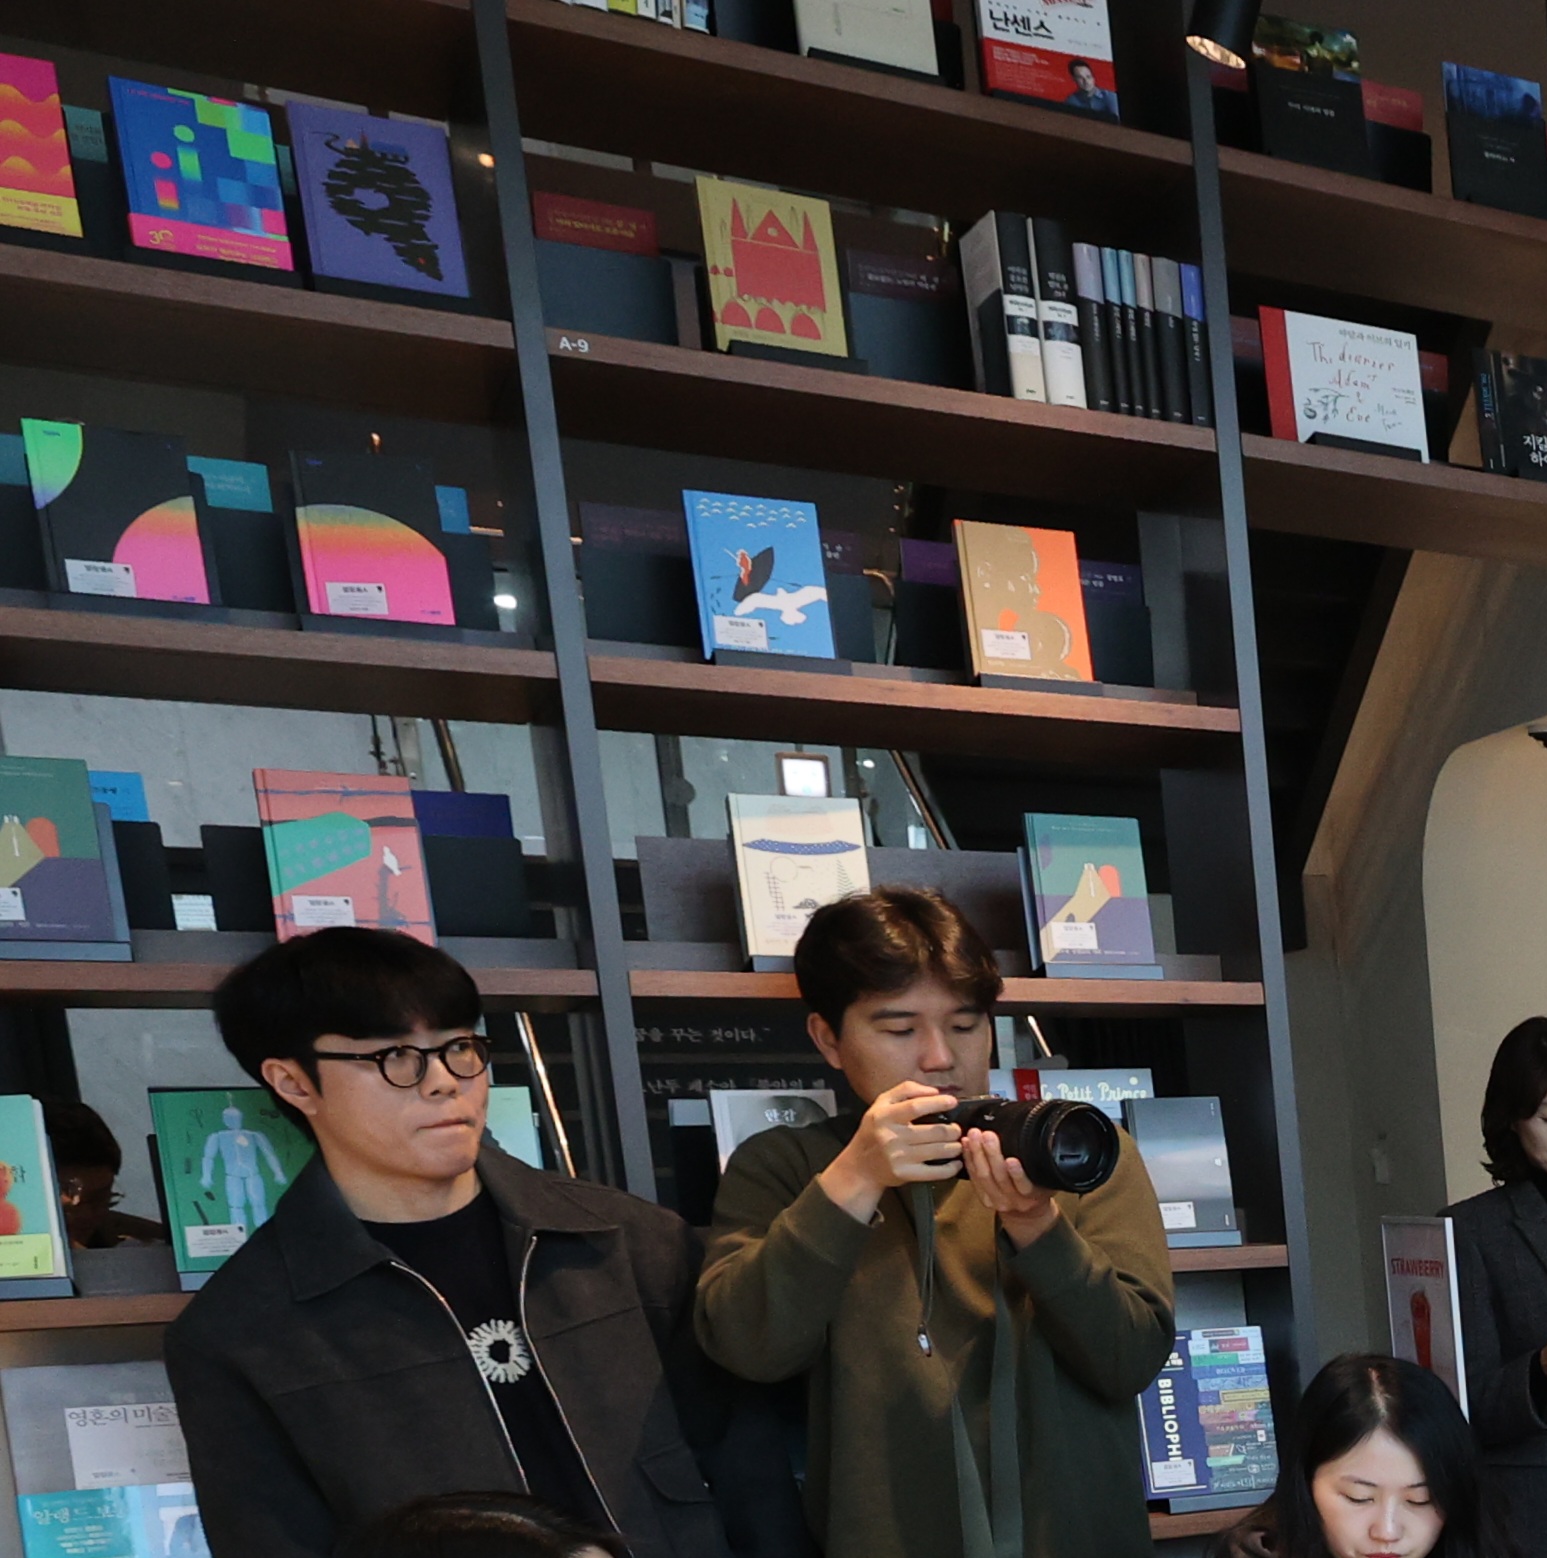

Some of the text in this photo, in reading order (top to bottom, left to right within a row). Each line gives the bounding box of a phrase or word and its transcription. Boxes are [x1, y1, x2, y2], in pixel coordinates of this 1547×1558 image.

[990, 10, 1054, 40] 난센스
[559, 337, 589, 353] A-9
[670, 1027, 703, 1043] 꾸는
[641, 1079, 681, 1094] 난두
[1056, 1081, 1148, 1101] Petit Prince
[67, 1406, 129, 1428] 영혼의
